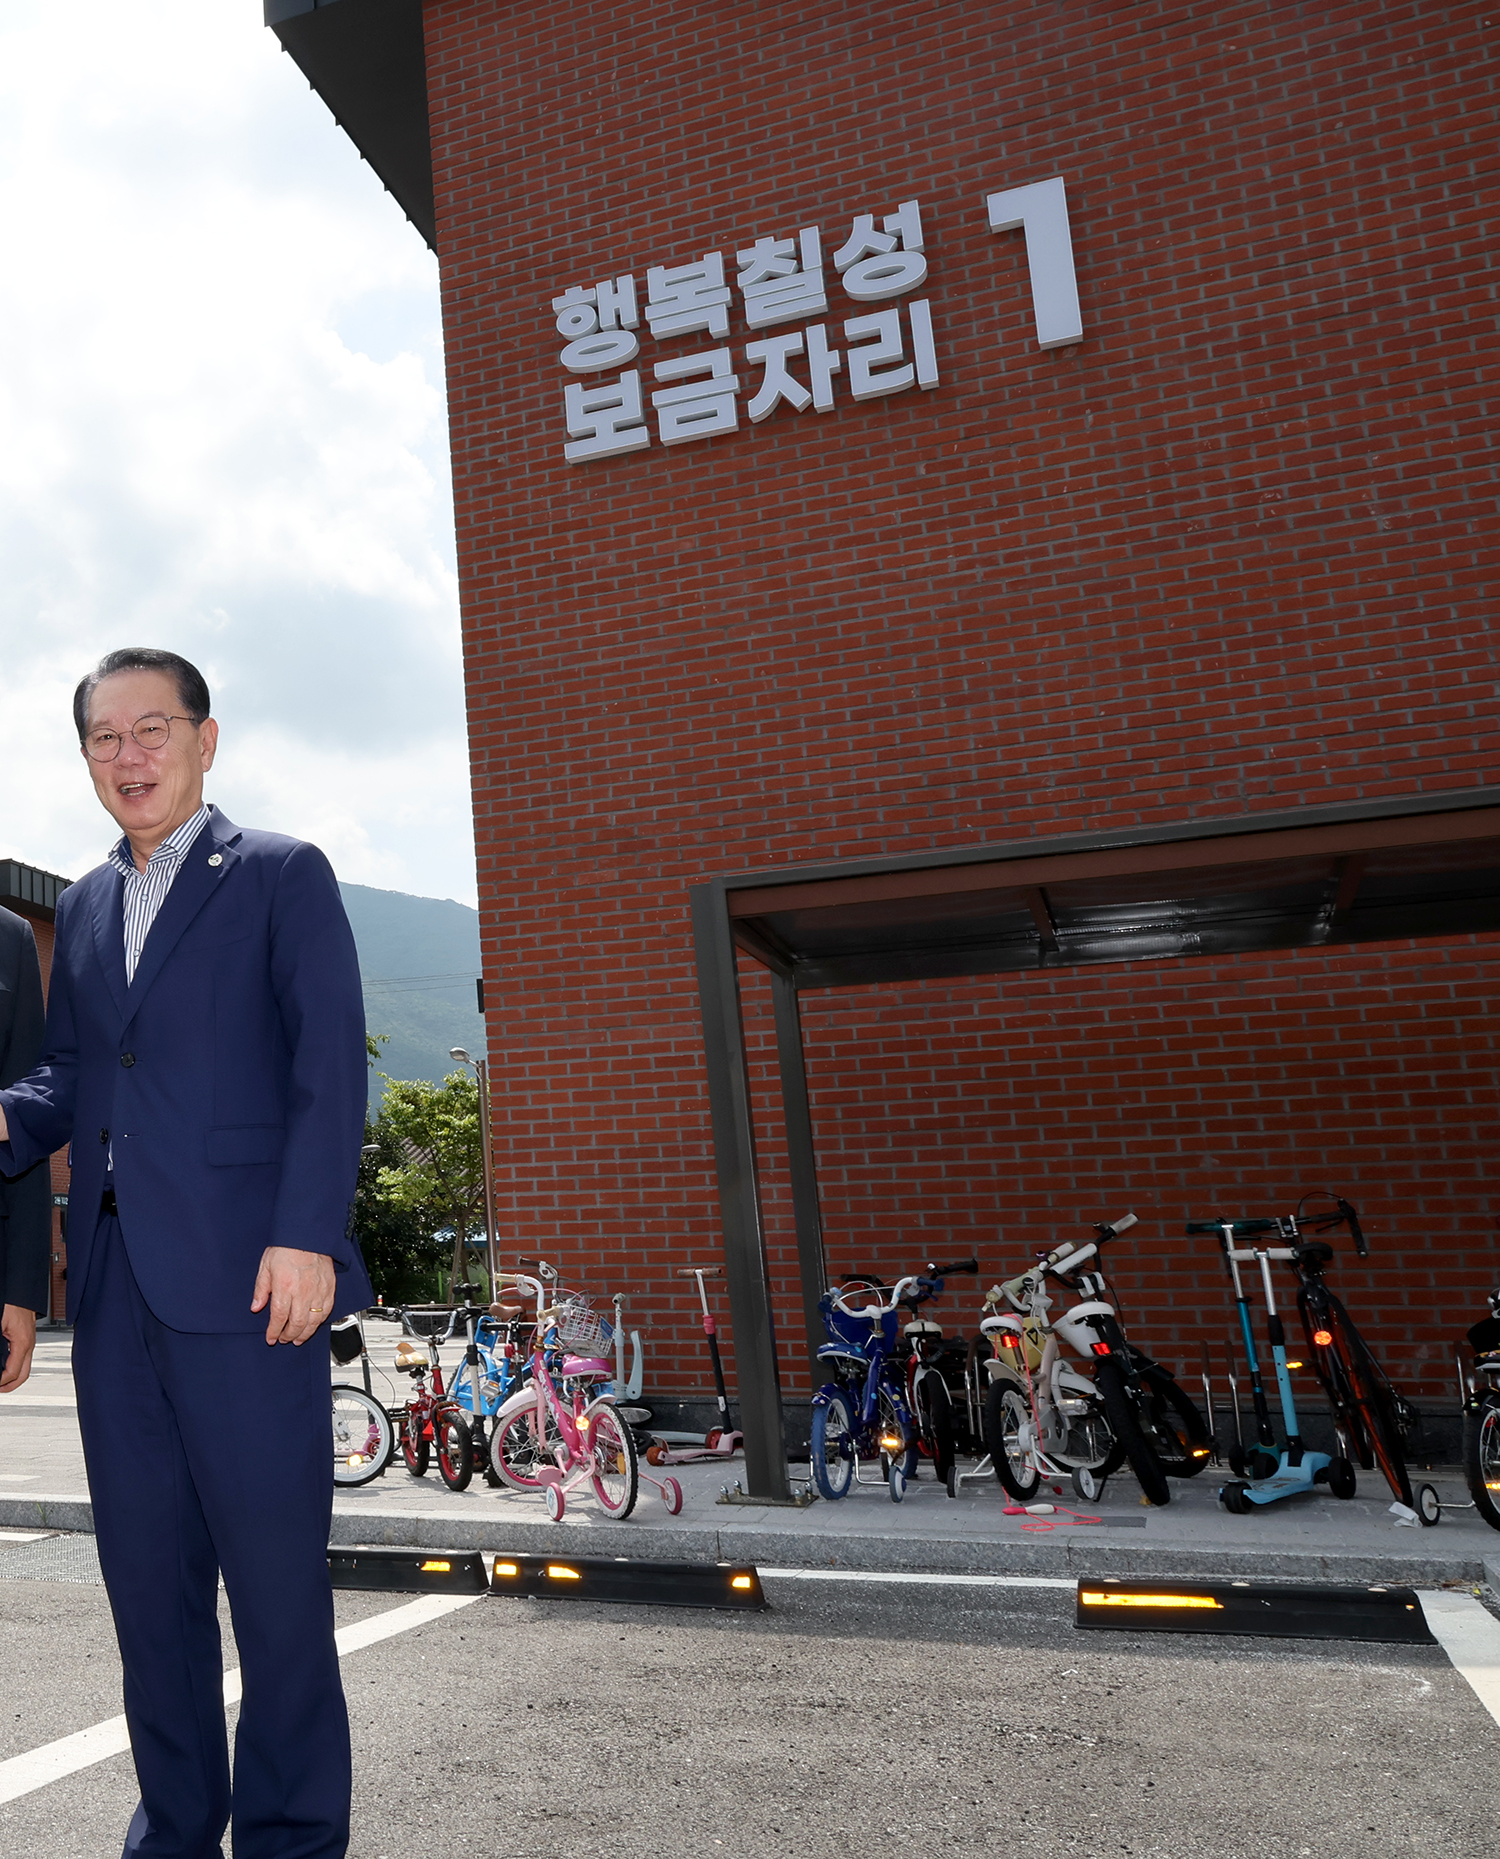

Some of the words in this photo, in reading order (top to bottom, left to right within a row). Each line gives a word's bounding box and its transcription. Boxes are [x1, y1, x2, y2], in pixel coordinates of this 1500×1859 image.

[552, 199, 928, 373] 행복칠성
[987, 176, 1083, 350] 1
[564, 298, 939, 464] 보금자리
